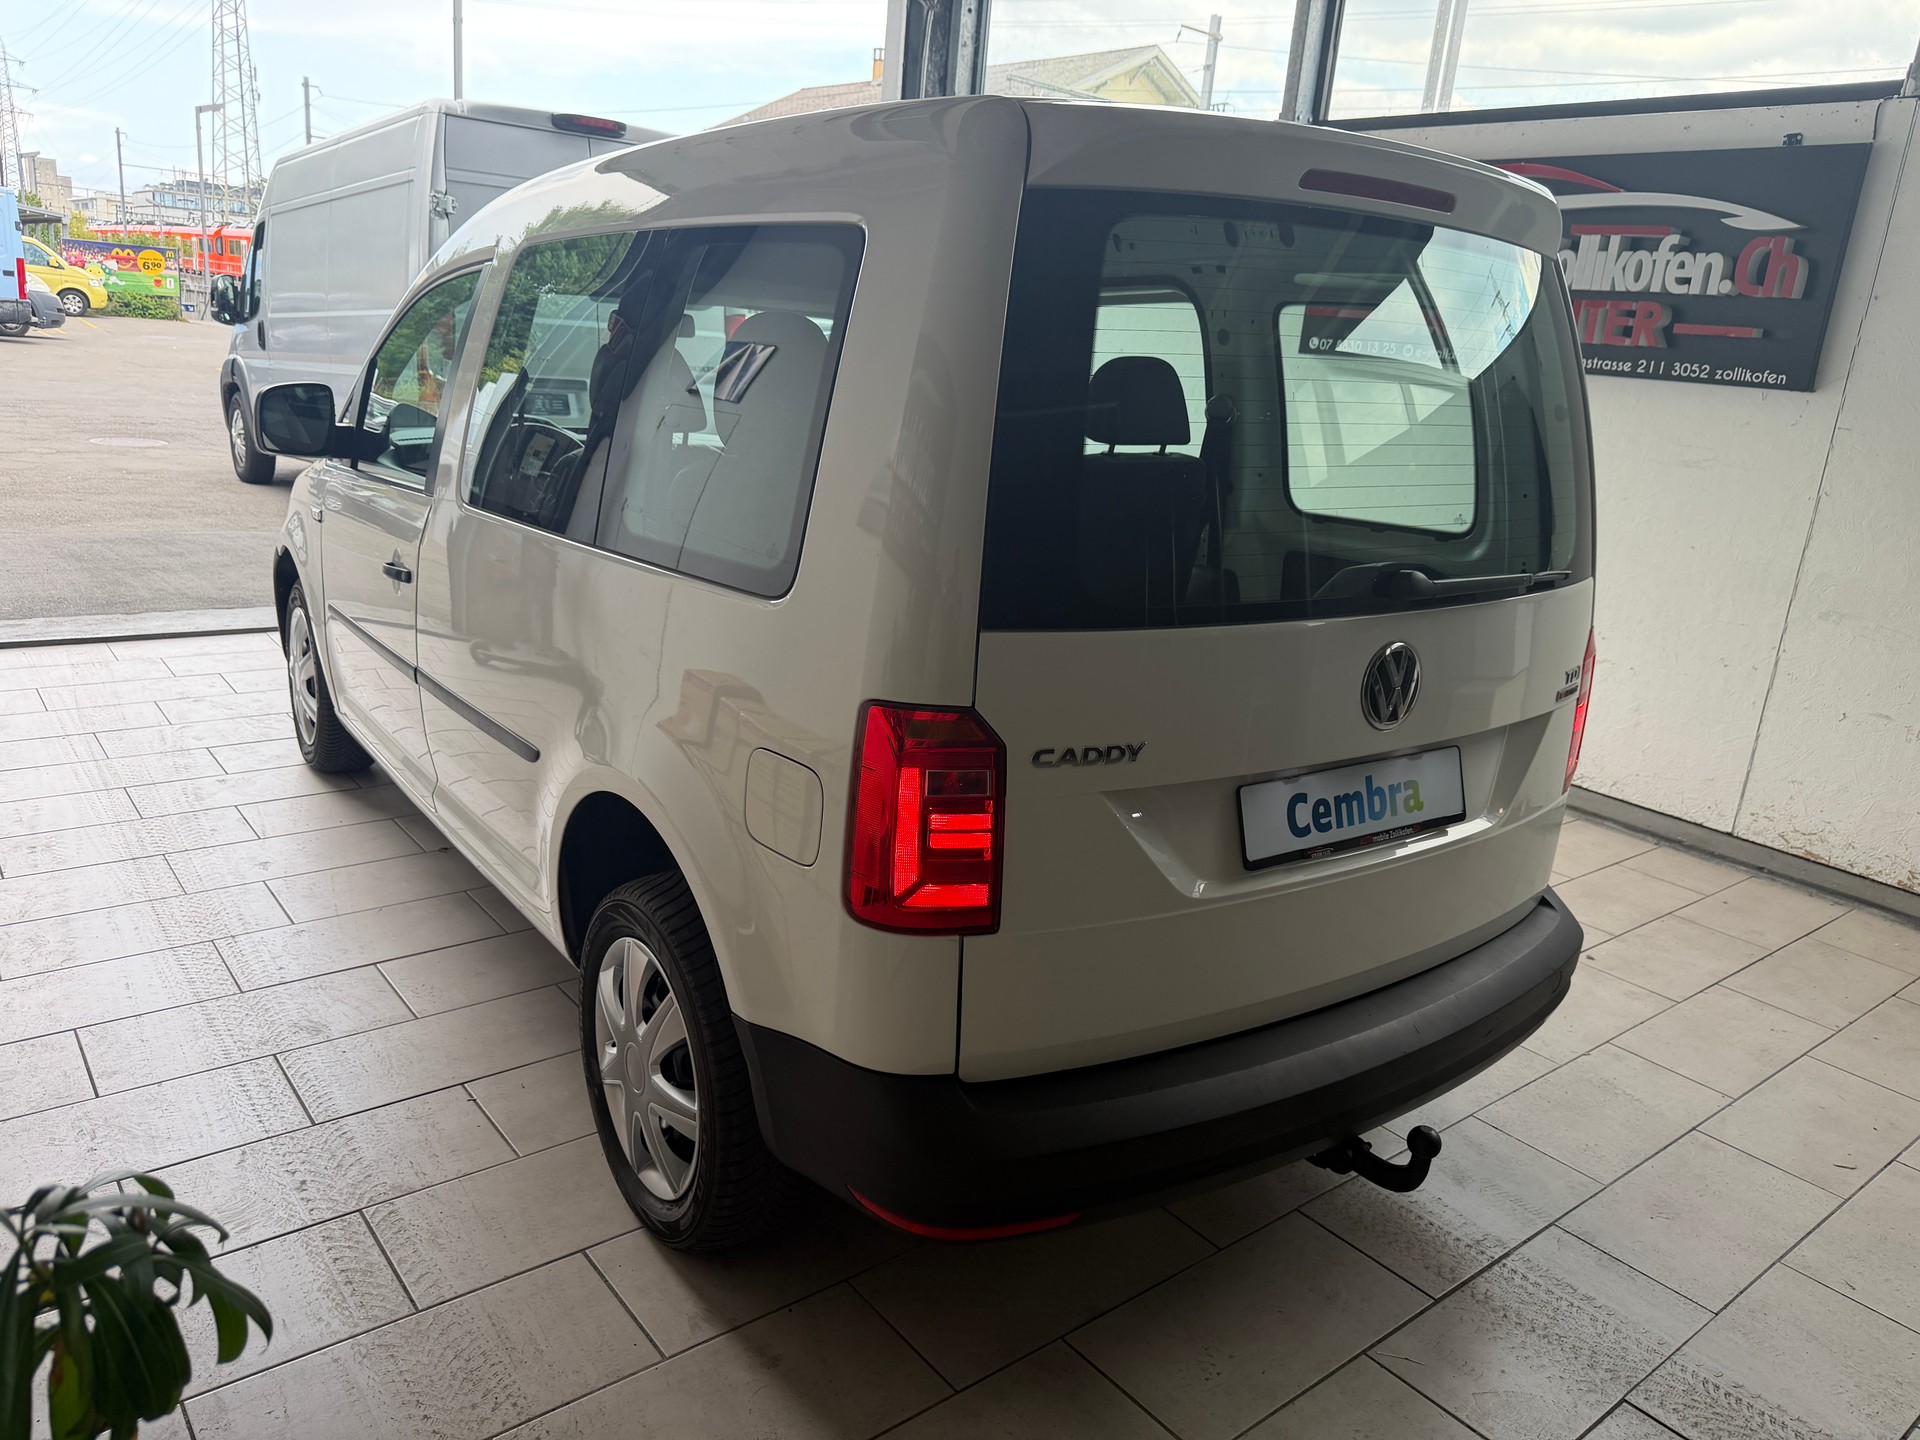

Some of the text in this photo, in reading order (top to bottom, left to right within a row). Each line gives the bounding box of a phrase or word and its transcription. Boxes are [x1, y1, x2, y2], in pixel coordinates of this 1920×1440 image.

[1558, 233, 1802, 298] ollikofen.Ch
[1637, 360, 1665, 375] 211
[1671, 363, 1710, 379] 3052
[1714, 366, 1787, 385] zollikofen
[1030, 741, 1147, 769] CADDY
[1286, 774, 1424, 839] Cembra
